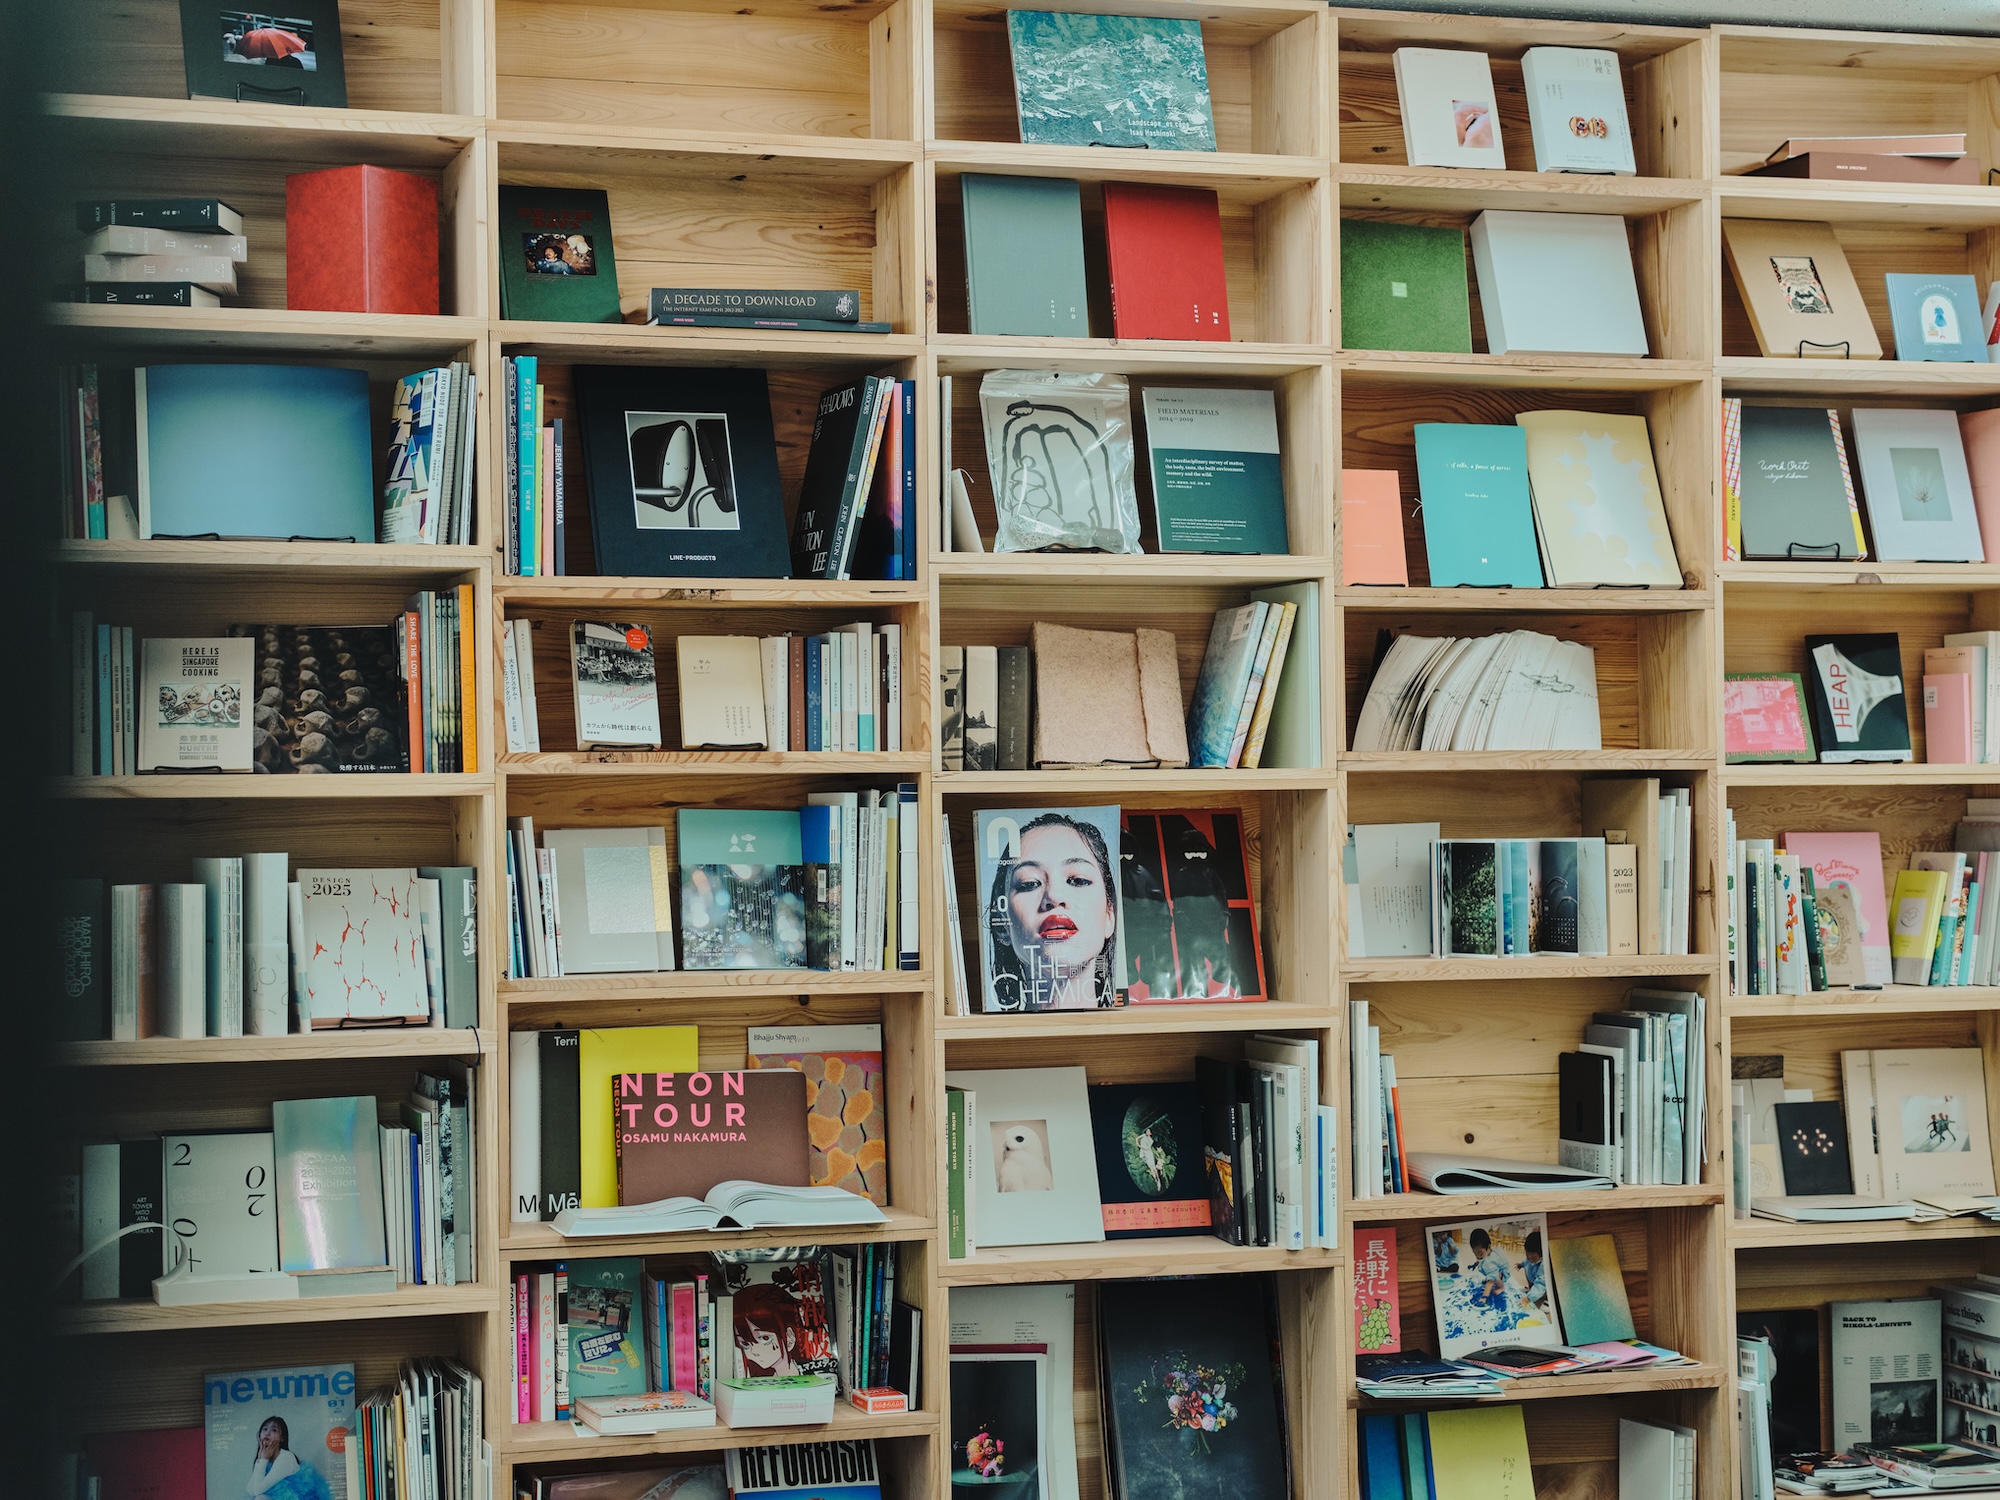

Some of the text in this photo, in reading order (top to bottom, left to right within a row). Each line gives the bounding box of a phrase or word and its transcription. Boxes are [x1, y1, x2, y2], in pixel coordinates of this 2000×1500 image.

[662, 294, 816, 307] A DECADE TO DOWNLOAD
[862, 384, 874, 416] SHADOWS
[1179, 408, 1220, 417] MATERIALS
[1172, 458, 1208, 466] interdisciplinary
[1757, 459, 1810, 471] Work Out
[669, 554, 717, 562] LINE-PRODUCTS
[812, 551, 827, 573] LEE
[182, 647, 220, 656] HERE IS
[409, 617, 418, 679] SHARE THE LOVE
[182, 657, 219, 666] SINGAPORE
[182, 668, 219, 677] COOKING
[1829, 663, 1853, 729] HEAP
[586, 722, 653, 732] カフェから時代は創られる
[987, 816, 1021, 858] n
[1613, 868, 1634, 877] 2023
[312, 883, 352, 896] 2025
[80, 916, 92, 987] MARUHIRO
[1023, 945, 1068, 980] THE
[554, 1035, 578, 1047] Terri
[753, 1033, 798, 1044] Bhajju Shyam
[621, 1072, 745, 1098] NEON
[613, 1079, 622, 1158] NEON TOUR
[621, 1102, 746, 1129] TOUR
[622, 1131, 748, 1144] OSAMU NAKAMURA
[302, 1178, 357, 1191] Exhibition
[1365, 1239, 1390, 1297] 長野に
[1946, 1304, 1986, 1325] nice things.
[596, 1366, 617, 1374] Edition
[205, 1370, 355, 1406] newme
